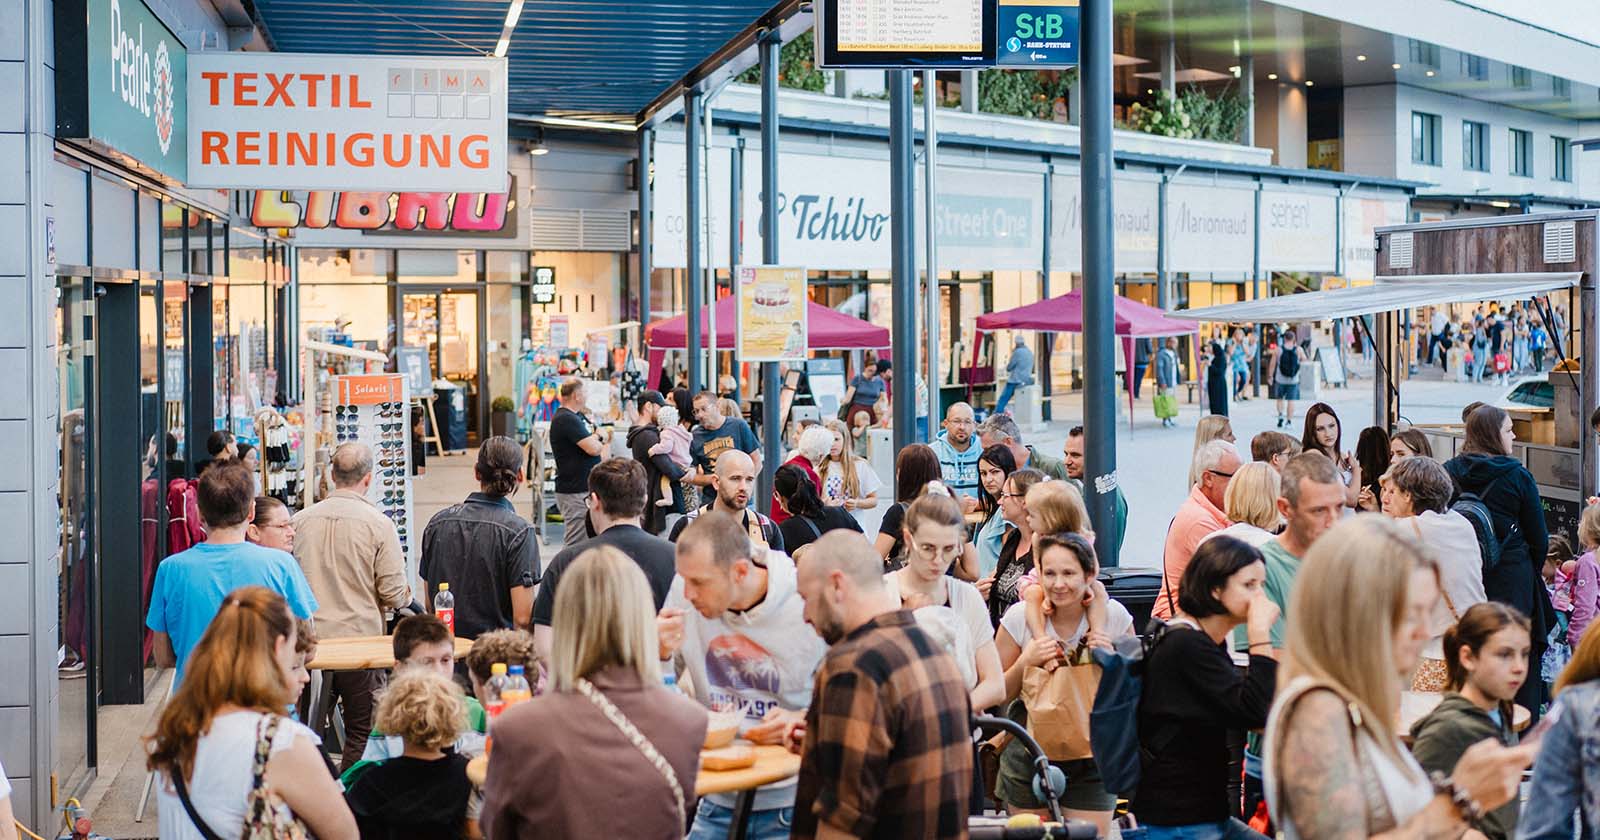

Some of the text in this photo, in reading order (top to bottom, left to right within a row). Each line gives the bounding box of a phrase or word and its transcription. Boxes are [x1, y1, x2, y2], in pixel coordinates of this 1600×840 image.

[1015, 12, 1064, 39] StB
[111, 0, 151, 118] Pearle
[201, 71, 372, 109] TEXTIL
[201, 130, 490, 169] REINIGUNG
[791, 194, 890, 242] Tchibo
[992, 206, 1028, 239] One
[1172, 201, 1248, 240] Marionnaud
